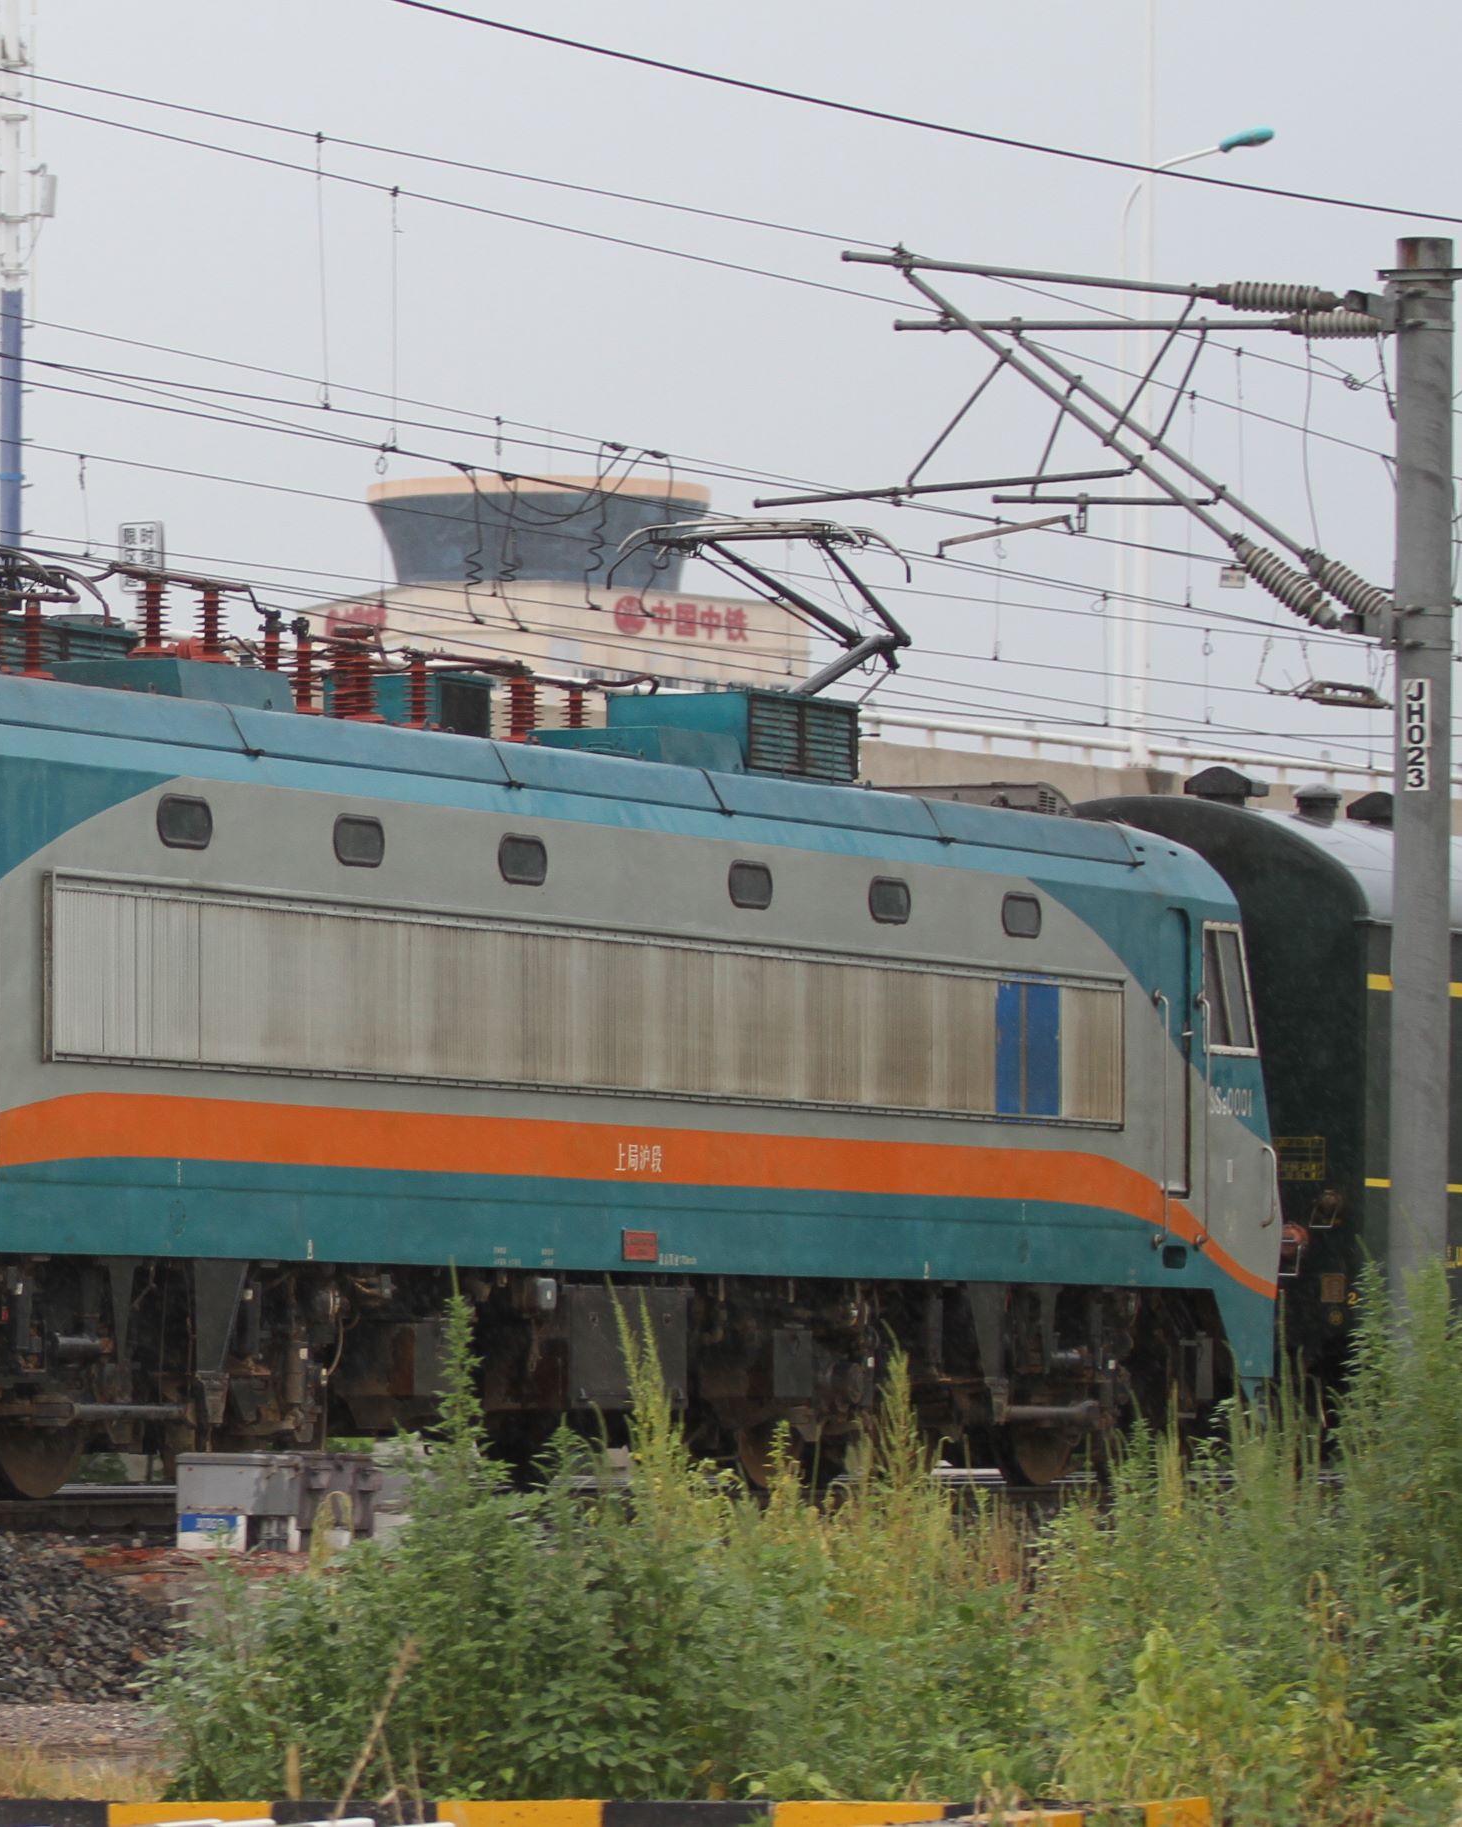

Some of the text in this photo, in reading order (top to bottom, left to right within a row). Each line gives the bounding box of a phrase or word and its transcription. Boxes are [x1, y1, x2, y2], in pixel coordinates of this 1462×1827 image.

[650, 601, 748, 642] 中国中铁
[1406, 681, 1426, 789] JH023
[614, 1143, 663, 1173] 上局沪段
